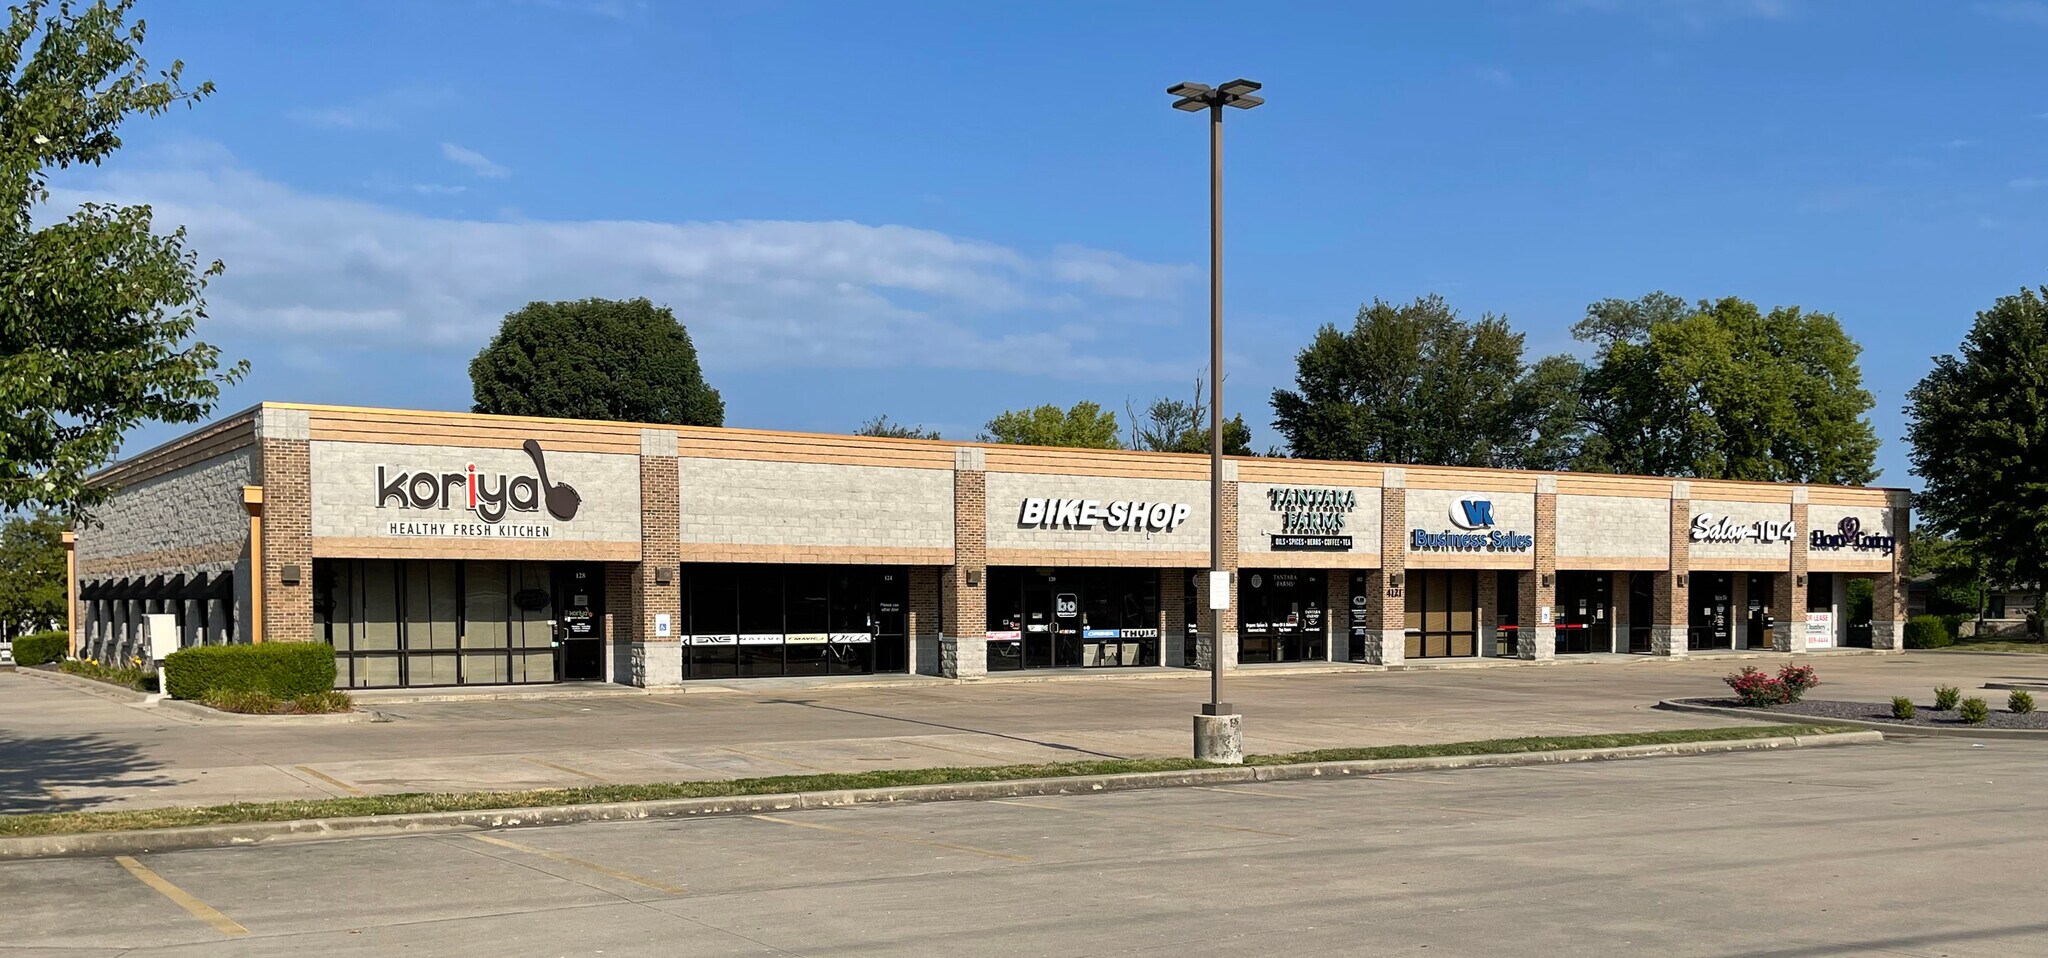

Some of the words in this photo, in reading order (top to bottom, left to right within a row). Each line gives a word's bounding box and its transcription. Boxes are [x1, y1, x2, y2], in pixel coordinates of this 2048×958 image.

[376, 463, 539, 523] koriya
[1271, 488, 1357, 507] TANTARA
[1021, 498, 1101, 525] BIKE
[1107, 500, 1192, 529] SHOP
[1286, 512, 1345, 530] FARMS
[1460, 500, 1495, 527] VR
[390, 522, 446, 536] HEALTHY
[453, 523, 491, 537] FRESH
[499, 525, 550, 538] KITCHEN
[1691, 512, 1748, 540] Salon
[1757, 520, 1797, 541] 104
[1275, 537, 1286, 546] OILS
[1288, 537, 1304, 546] SPICES
[1306, 537, 1322, 546] HERBS
[1324, 538, 1340, 546] COFFEE
[1342, 538, 1351, 546] TEA
[1415, 529, 1488, 548] Business
[1492, 530, 1533, 548] Sales
[1386, 588, 1402, 598] 4121
[1122, 630, 1157, 638] THULE
